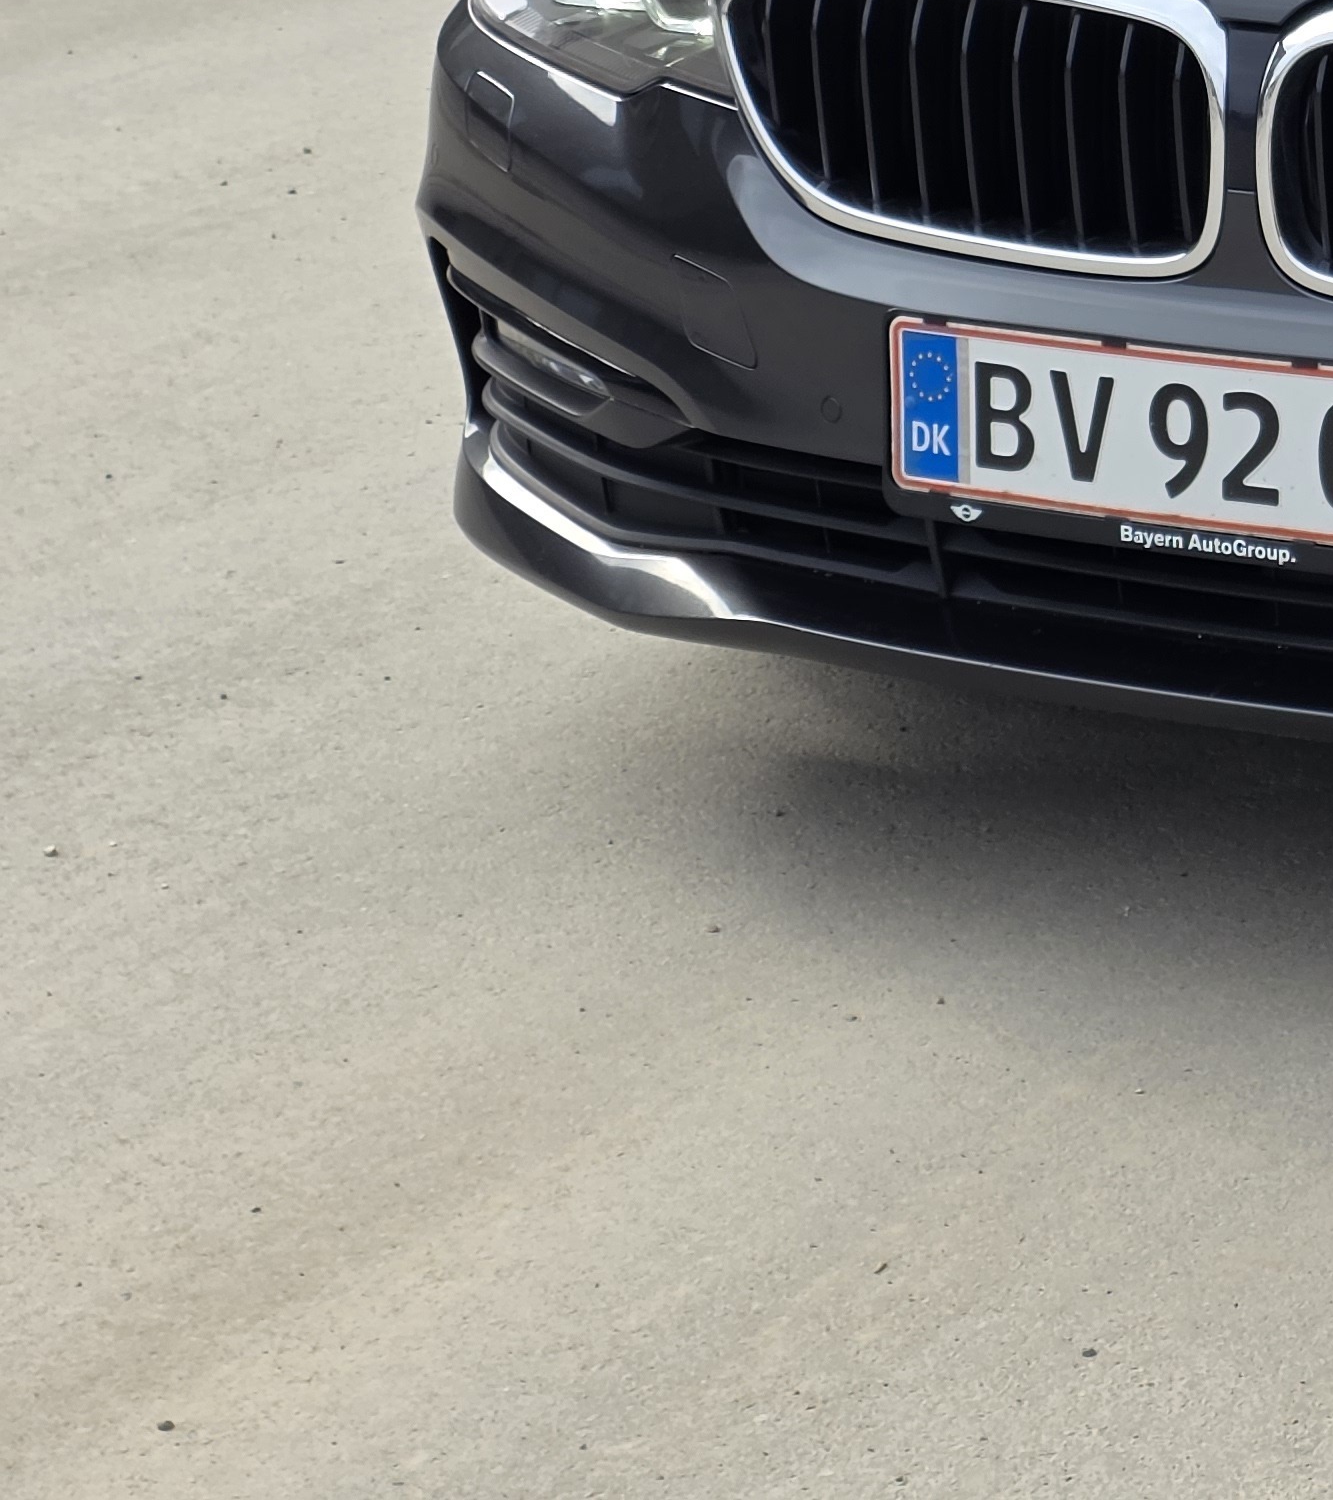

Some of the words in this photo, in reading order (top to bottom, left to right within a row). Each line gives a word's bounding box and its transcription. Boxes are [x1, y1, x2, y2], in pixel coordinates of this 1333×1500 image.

[911, 420, 951, 457] DK
[974, 361, 1115, 483] BV
[1149, 383, 1280, 507] 92
[1120, 524, 1184, 549] Bayern
[1187, 533, 1297, 566] AutoGroup.
